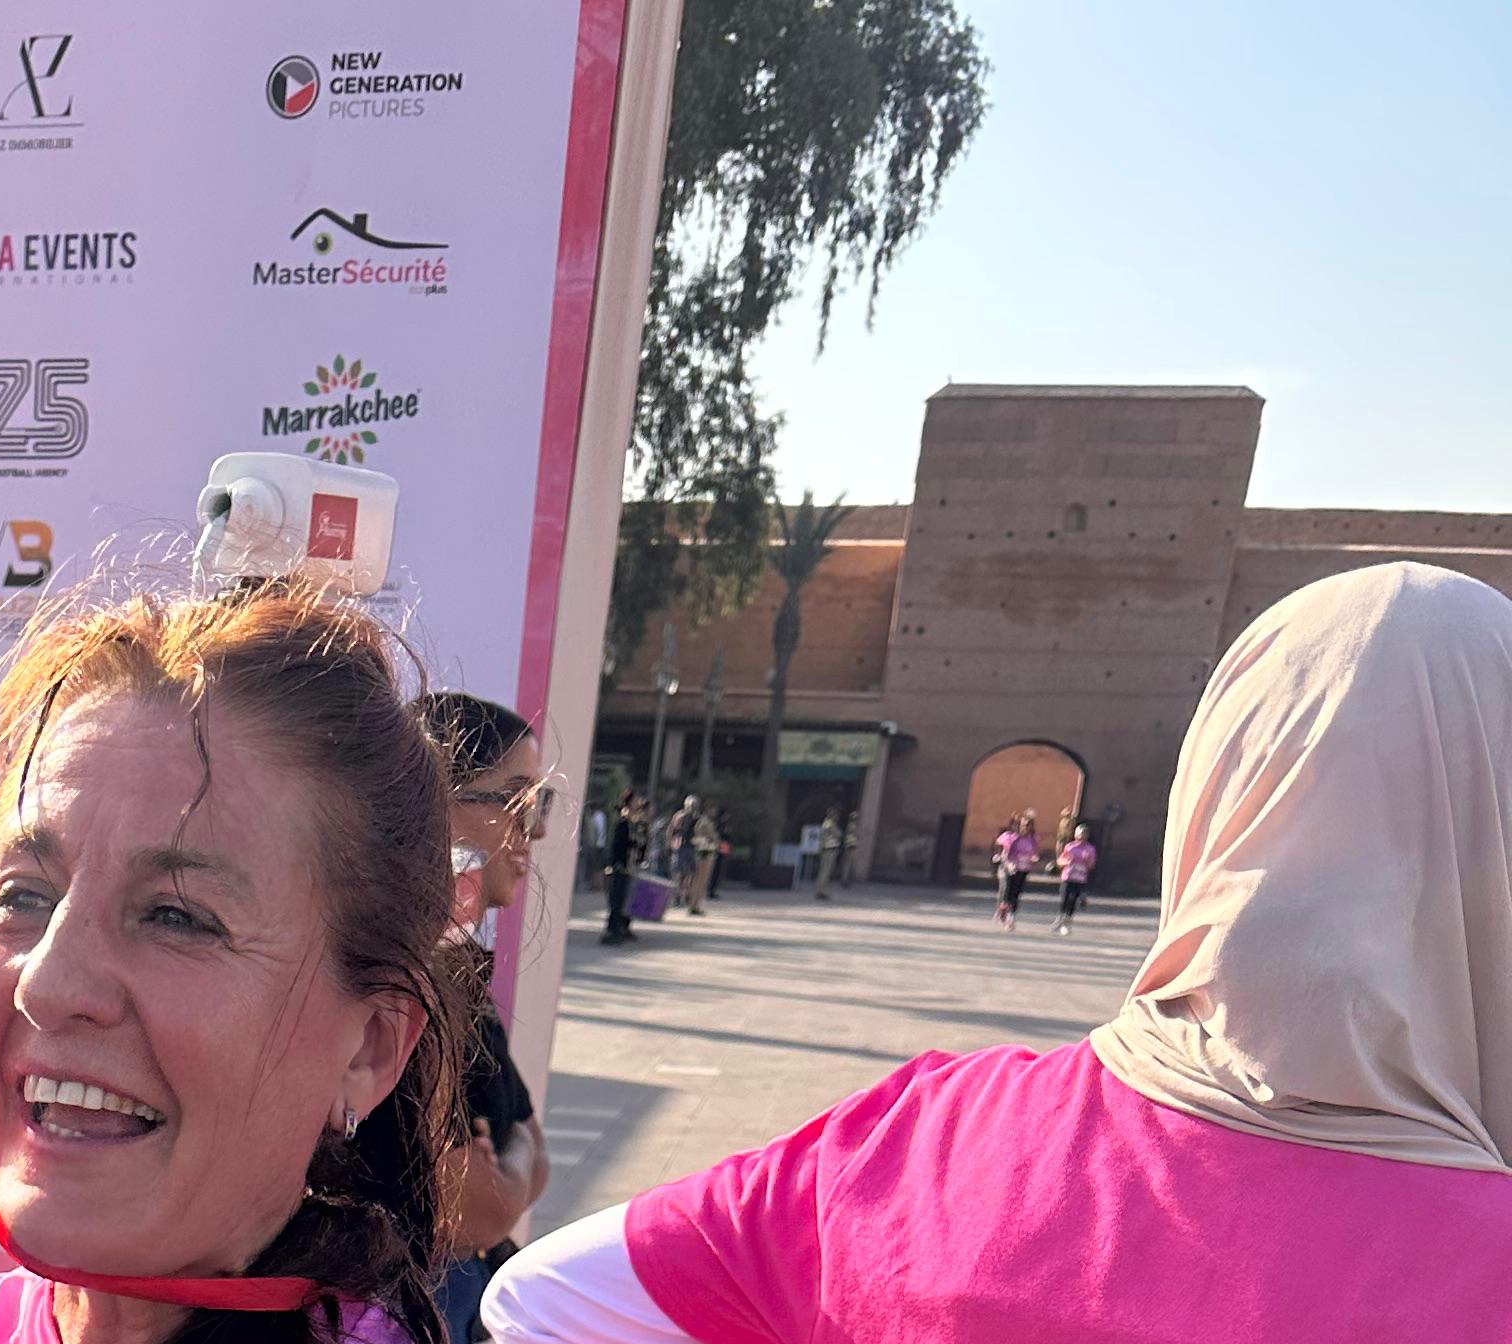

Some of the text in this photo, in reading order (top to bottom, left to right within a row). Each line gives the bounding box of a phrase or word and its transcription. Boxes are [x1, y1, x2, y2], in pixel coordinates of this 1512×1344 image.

[331, 52, 382, 71] NEW
[329, 73, 463, 95] GENERATION
[328, 98, 425, 119] PICTURES
[23, 232, 137, 271] EVENTS
[253, 256, 447, 286] MasterSécurité
[262, 388, 420, 437] Marrakchee
